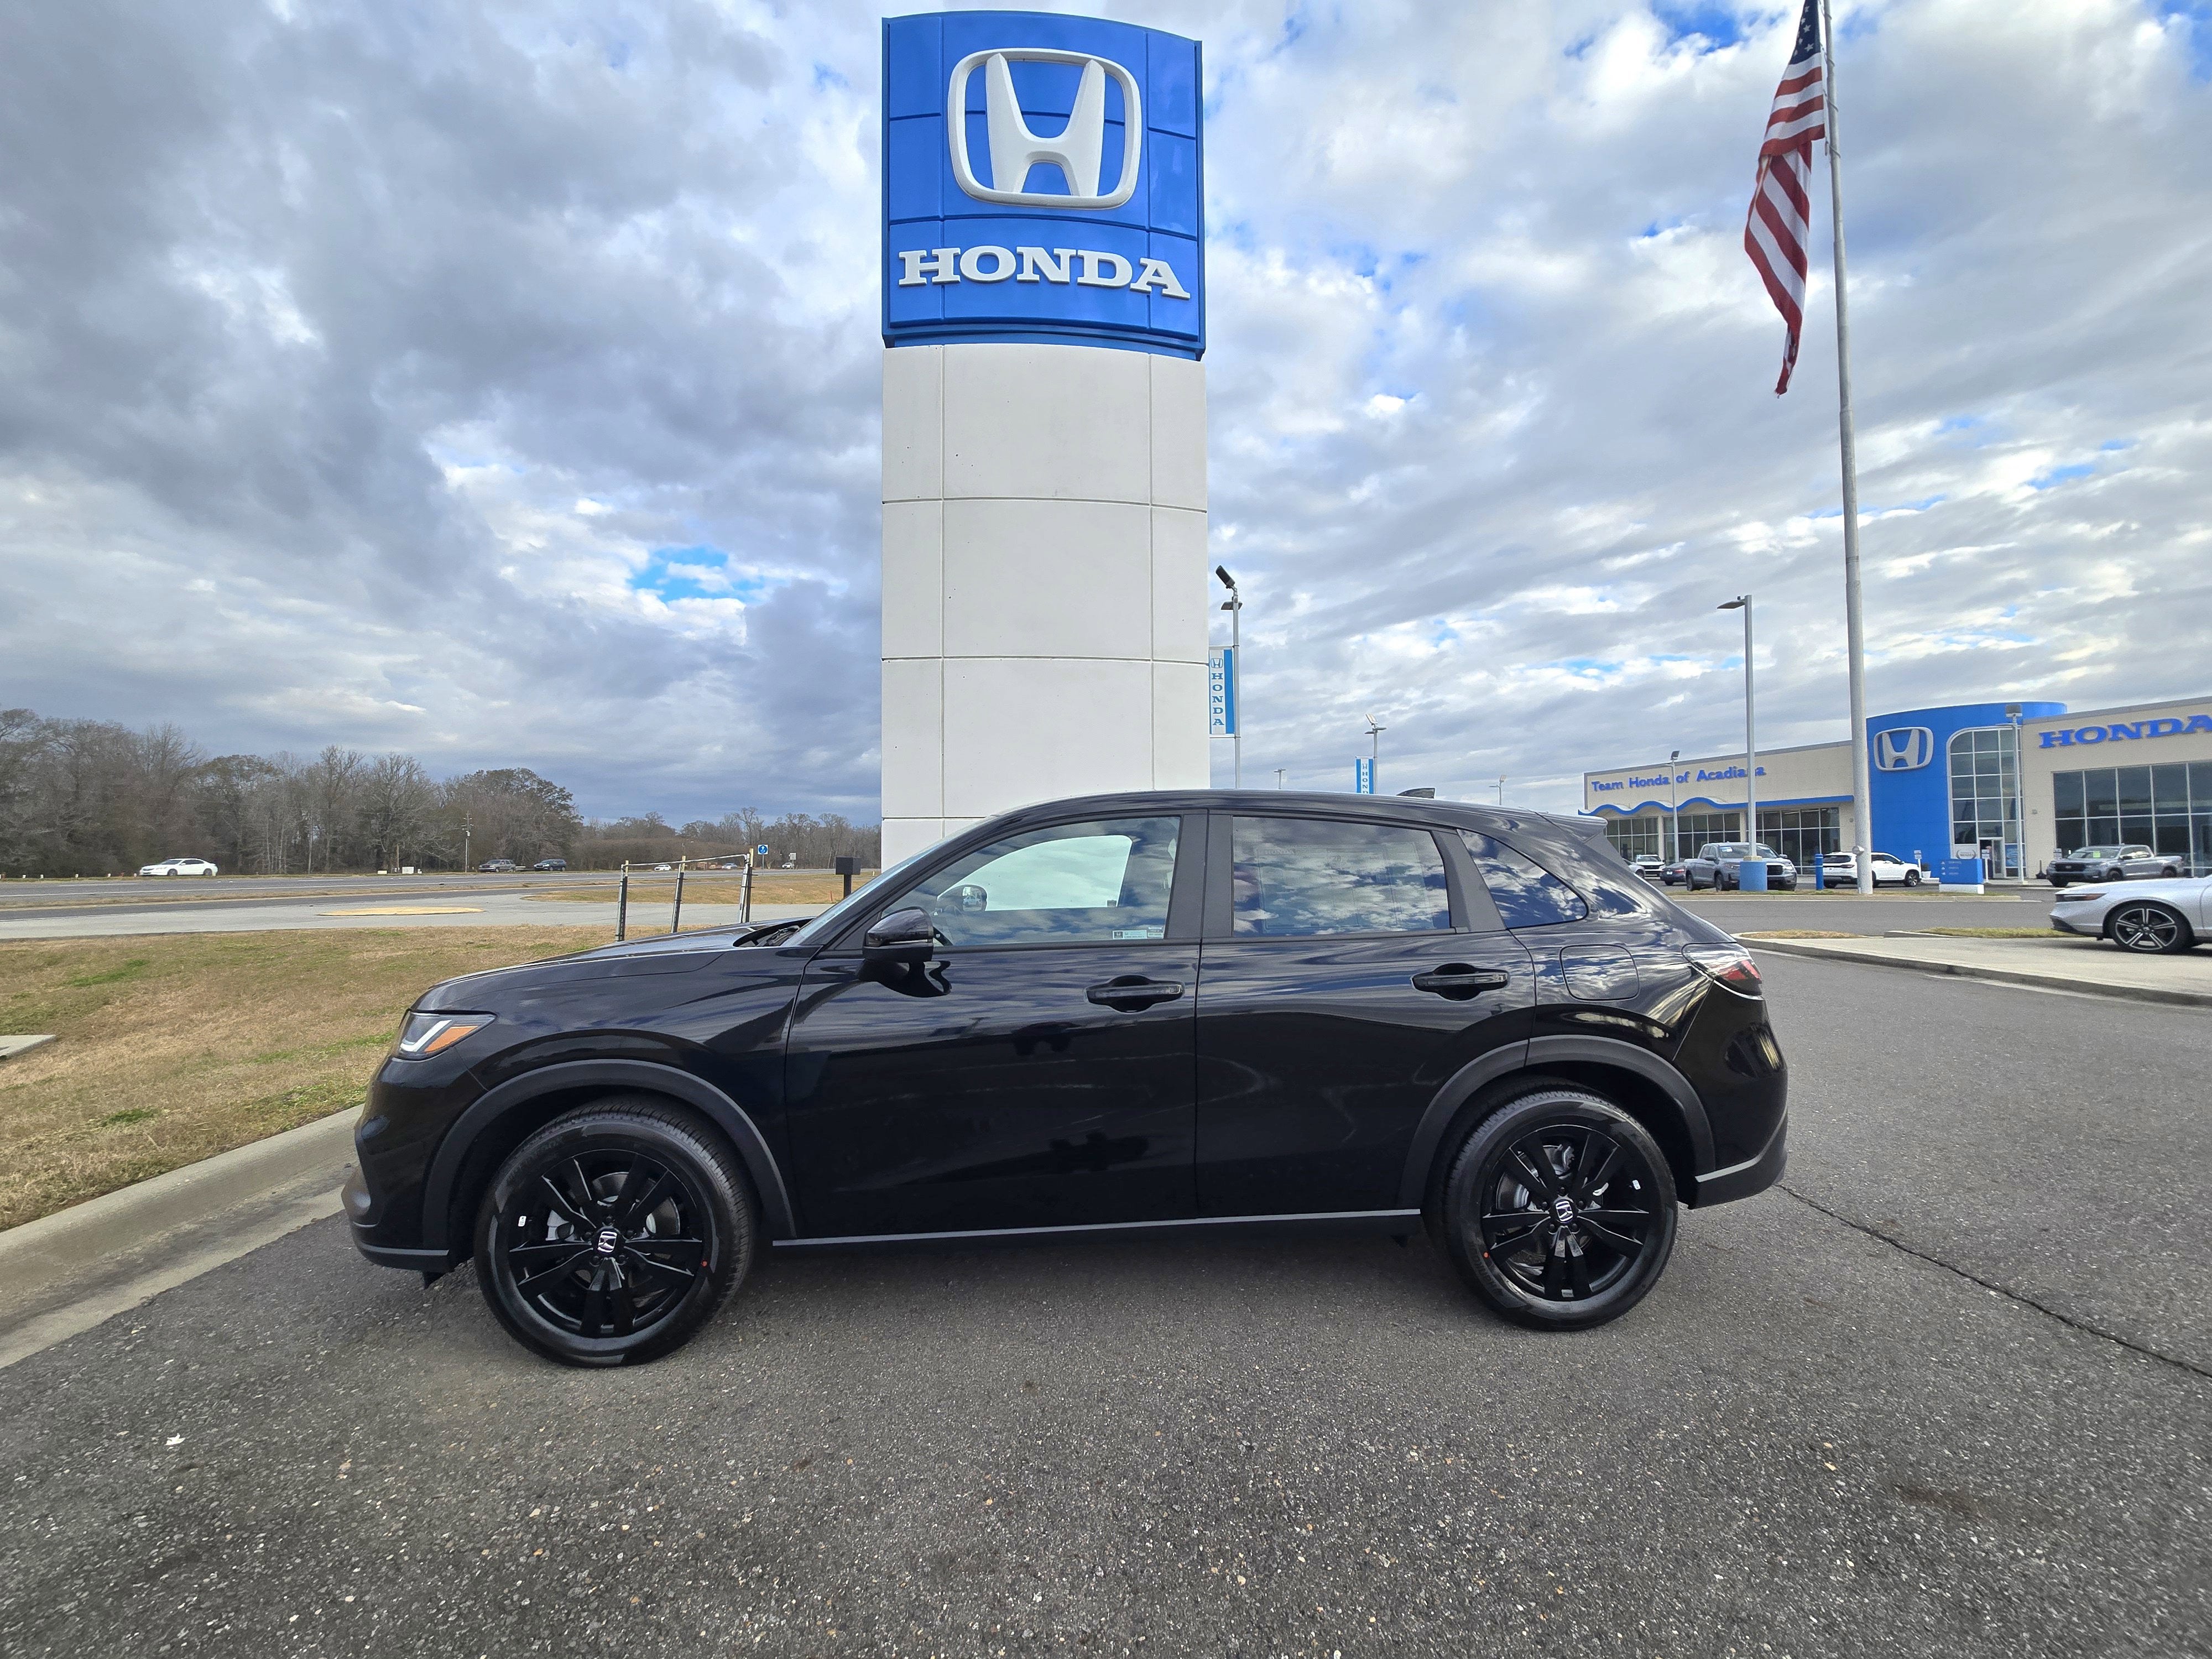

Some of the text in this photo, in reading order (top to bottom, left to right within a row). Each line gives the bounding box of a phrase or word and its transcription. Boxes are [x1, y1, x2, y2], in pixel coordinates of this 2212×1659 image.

[899, 246, 1191, 301] HONDA
[1212, 672, 1224, 726] HONDA
[2038, 714, 2212, 749] HONDA
[1591, 766, 1767, 792] Team Honda of Acadiaa
